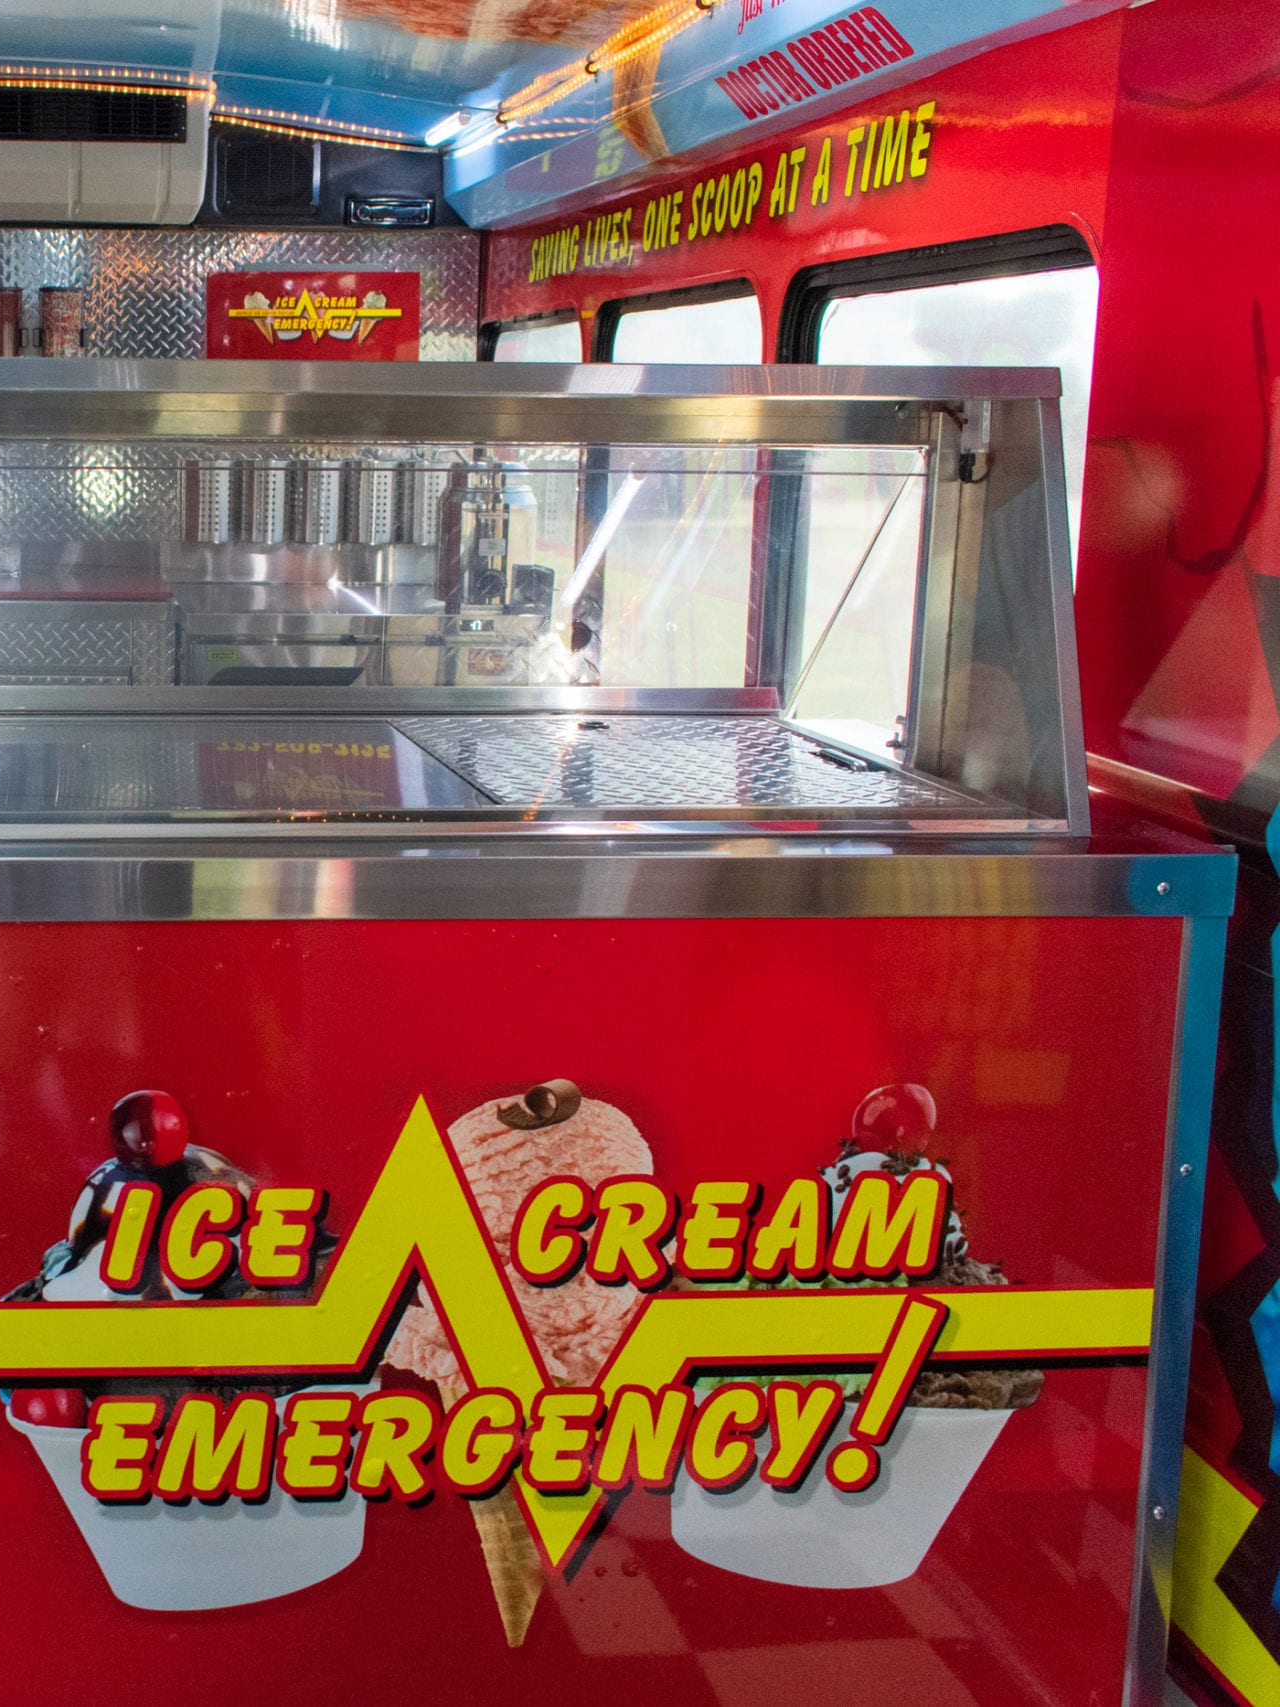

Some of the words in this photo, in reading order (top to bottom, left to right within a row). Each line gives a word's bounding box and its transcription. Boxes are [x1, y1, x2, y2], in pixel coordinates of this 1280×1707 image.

[714, 50, 817, 121] DOCTOR
[786, 6, 914, 90] ORDERED
[528, 224, 580, 284] SAVING
[583, 207, 634, 266] LIVES,
[643, 190, 683, 252] ONE
[688, 161, 763, 241] SCOOP
[768, 146, 806, 218] AT
[811, 137, 832, 206] A
[844, 101, 936, 197] TIME
[273, 308, 358, 331] EMERGENCY!
[275, 296, 297, 308] ICE
[314, 296, 358, 308] CREAM
[101, 1182, 320, 1290] ICE
[512, 1170, 949, 1286] CREAM
[82, 1294, 947, 1499] EMERGENCY!
